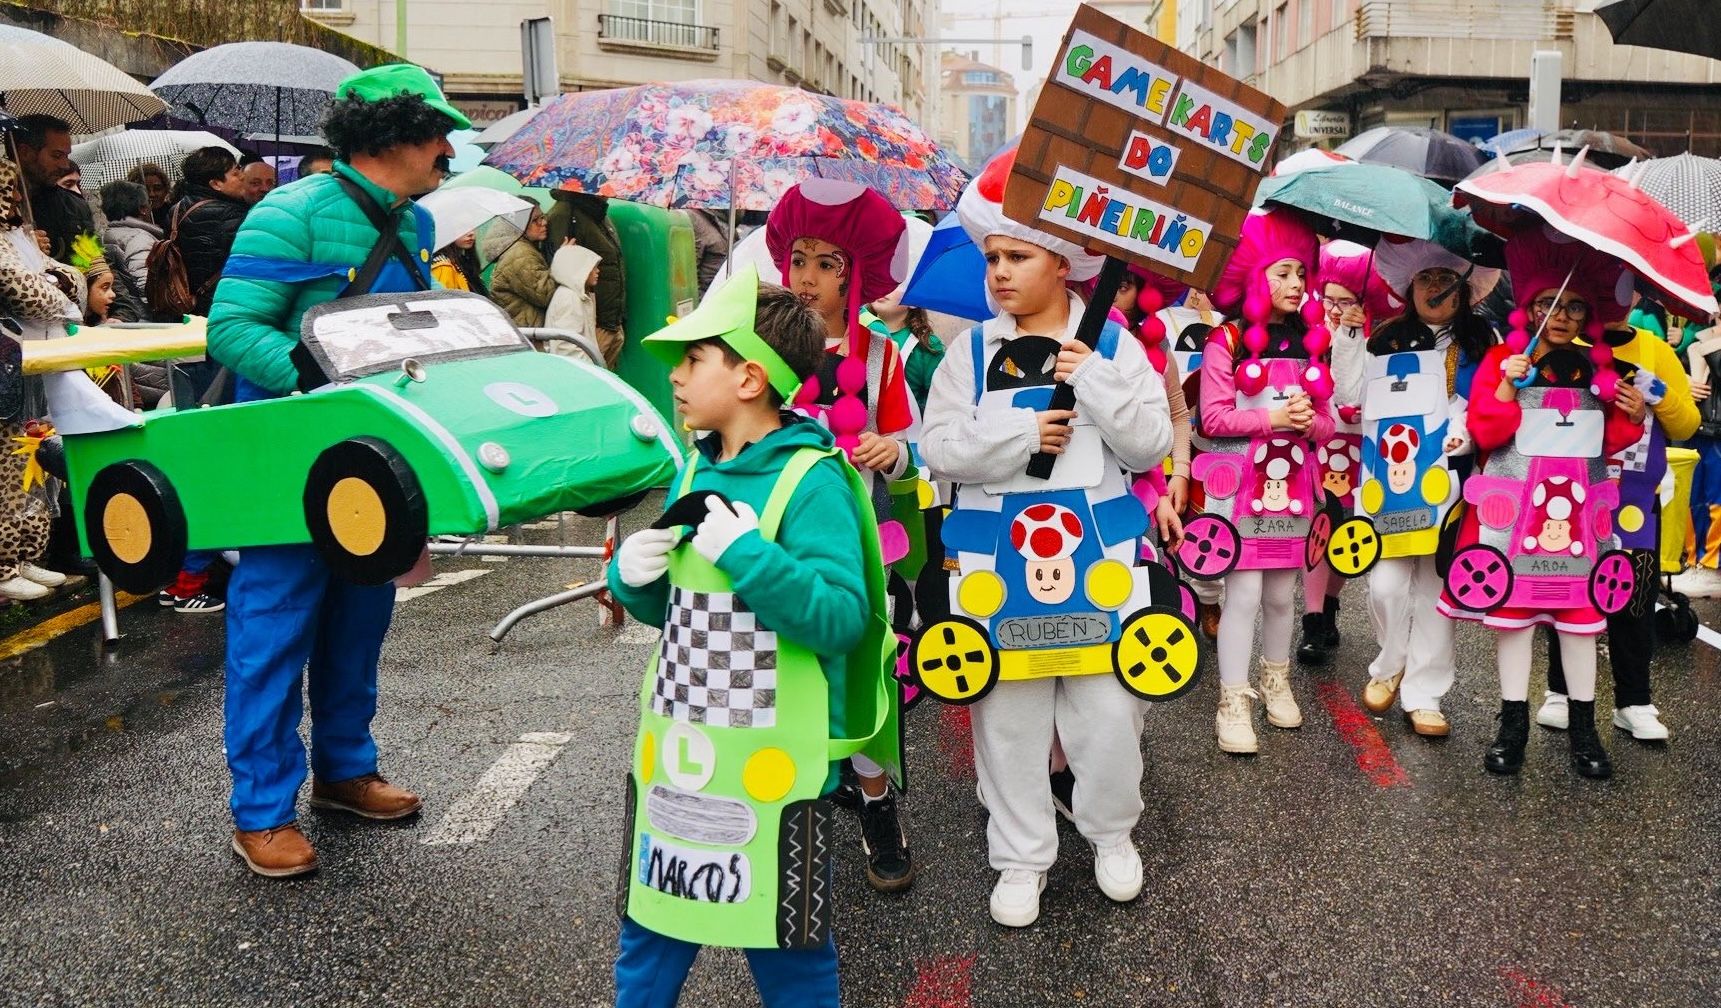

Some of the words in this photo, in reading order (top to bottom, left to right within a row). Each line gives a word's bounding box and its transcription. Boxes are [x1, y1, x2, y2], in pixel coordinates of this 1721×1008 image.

[463, 103, 515, 121] pical
[1066, 44, 1172, 114] GAME
[1170, 92, 1270, 164] KARTS
[1309, 126, 1346, 135] UNIVERSAL
[1124, 136, 1172, 177] DO
[1044, 178, 1204, 258] PIÑEIRIÑO
[1253, 518, 1295, 535] LARA
[1382, 514, 1427, 532] SABELA
[1530, 560, 1569, 572] AROA
[678, 736, 703, 776] L
[647, 845, 743, 904] MARCOS
